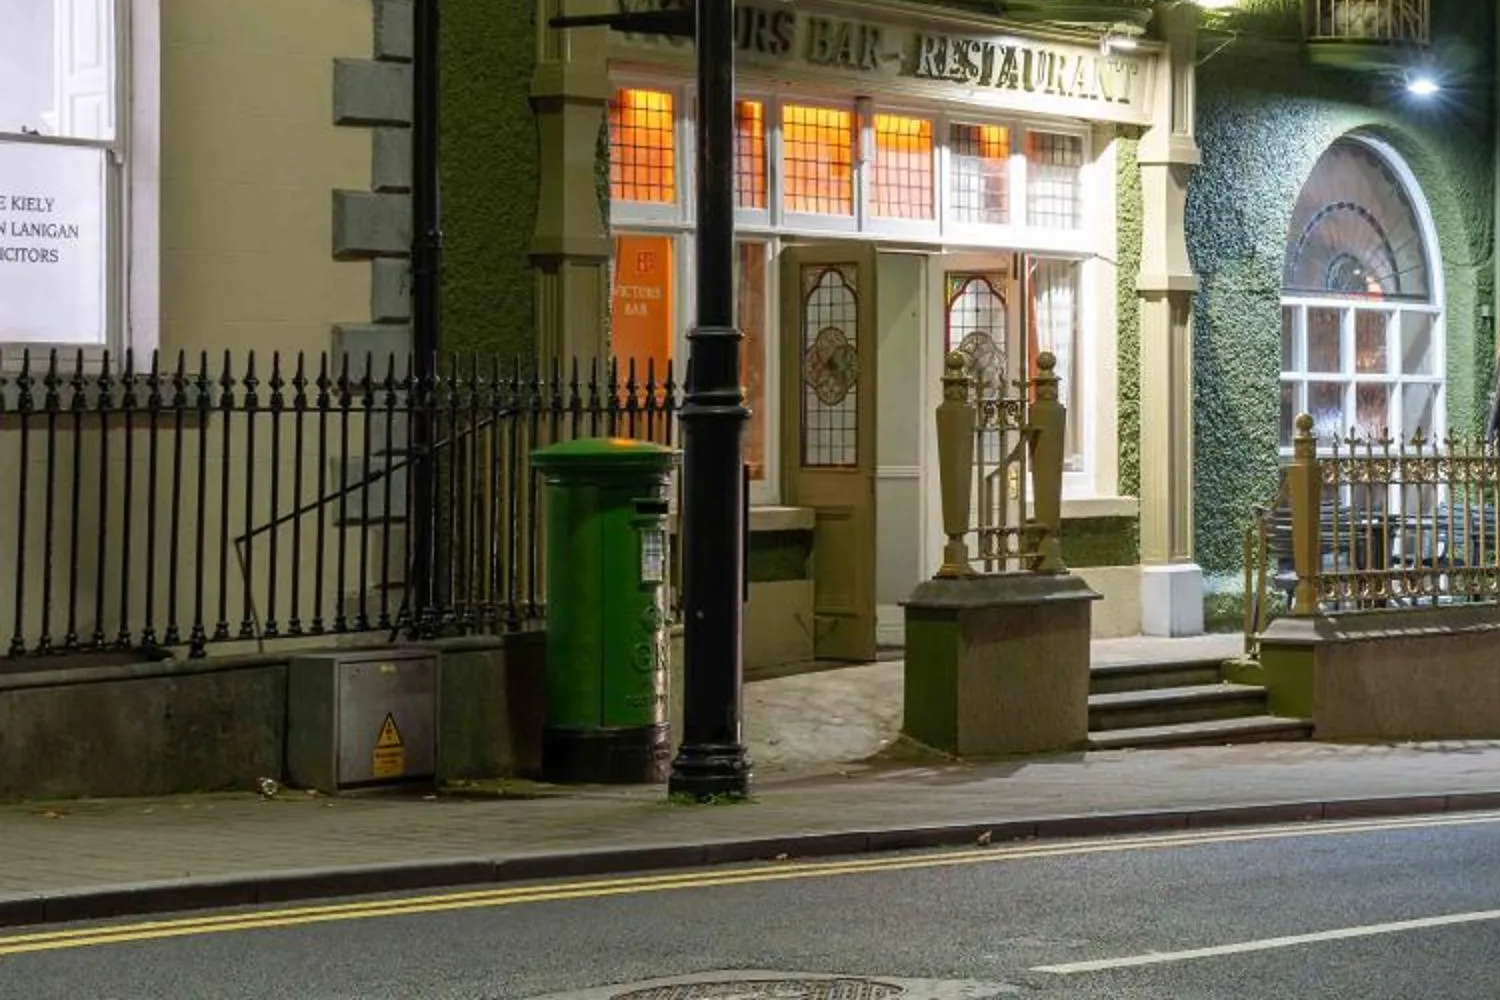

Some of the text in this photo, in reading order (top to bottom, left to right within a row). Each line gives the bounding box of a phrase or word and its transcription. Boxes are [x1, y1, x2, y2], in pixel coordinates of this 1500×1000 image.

[906, 33, 1142, 104] RESTAURANT
[11, 195, 56, 213] KIELY
[11, 221, 79, 239] LANIGAN
